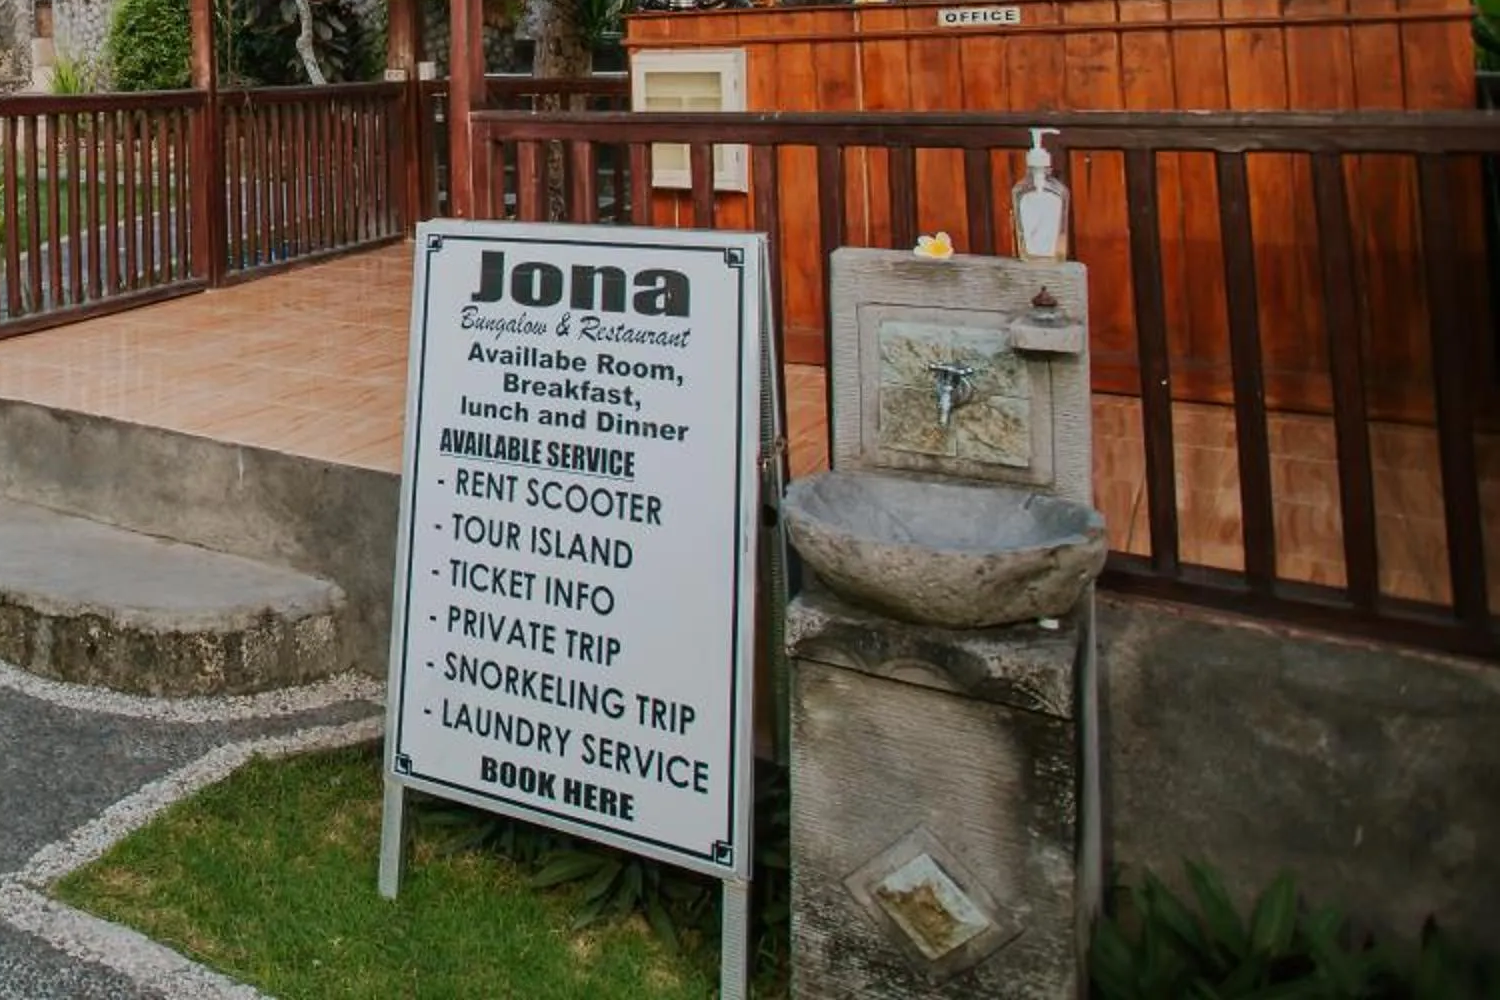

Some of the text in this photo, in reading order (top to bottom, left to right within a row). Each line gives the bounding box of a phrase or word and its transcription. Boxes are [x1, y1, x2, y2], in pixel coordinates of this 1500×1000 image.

[945, 9, 1016, 22] OFFICE
[470, 250, 691, 317] Jona
[460, 306, 693, 349] Bungalow & Restaurant
[468, 341, 686, 387] Availlabe Room,
[503, 372, 643, 412] Breakfast,
[460, 395, 691, 443] lunch and Dinner
[439, 427, 636, 478] AVAILABLE SERVICE
[455, 468, 518, 503] RENT
[526, 480, 663, 526] SCOOTER
[451, 512, 521, 550] TOUR
[531, 525, 634, 569] ISLAND
[449, 558, 537, 601] TICKET
[545, 576, 615, 616] INFO
[447, 605, 556, 654] PRIVATE
[565, 629, 621, 666] TRIP
[443, 651, 626, 720] SNORKELING
[636, 694, 696, 735] TRIP
[441, 698, 571, 758] LAUNDRY
[580, 732, 710, 794] SERVICE
[480, 755, 636, 821] BOOK HERE
